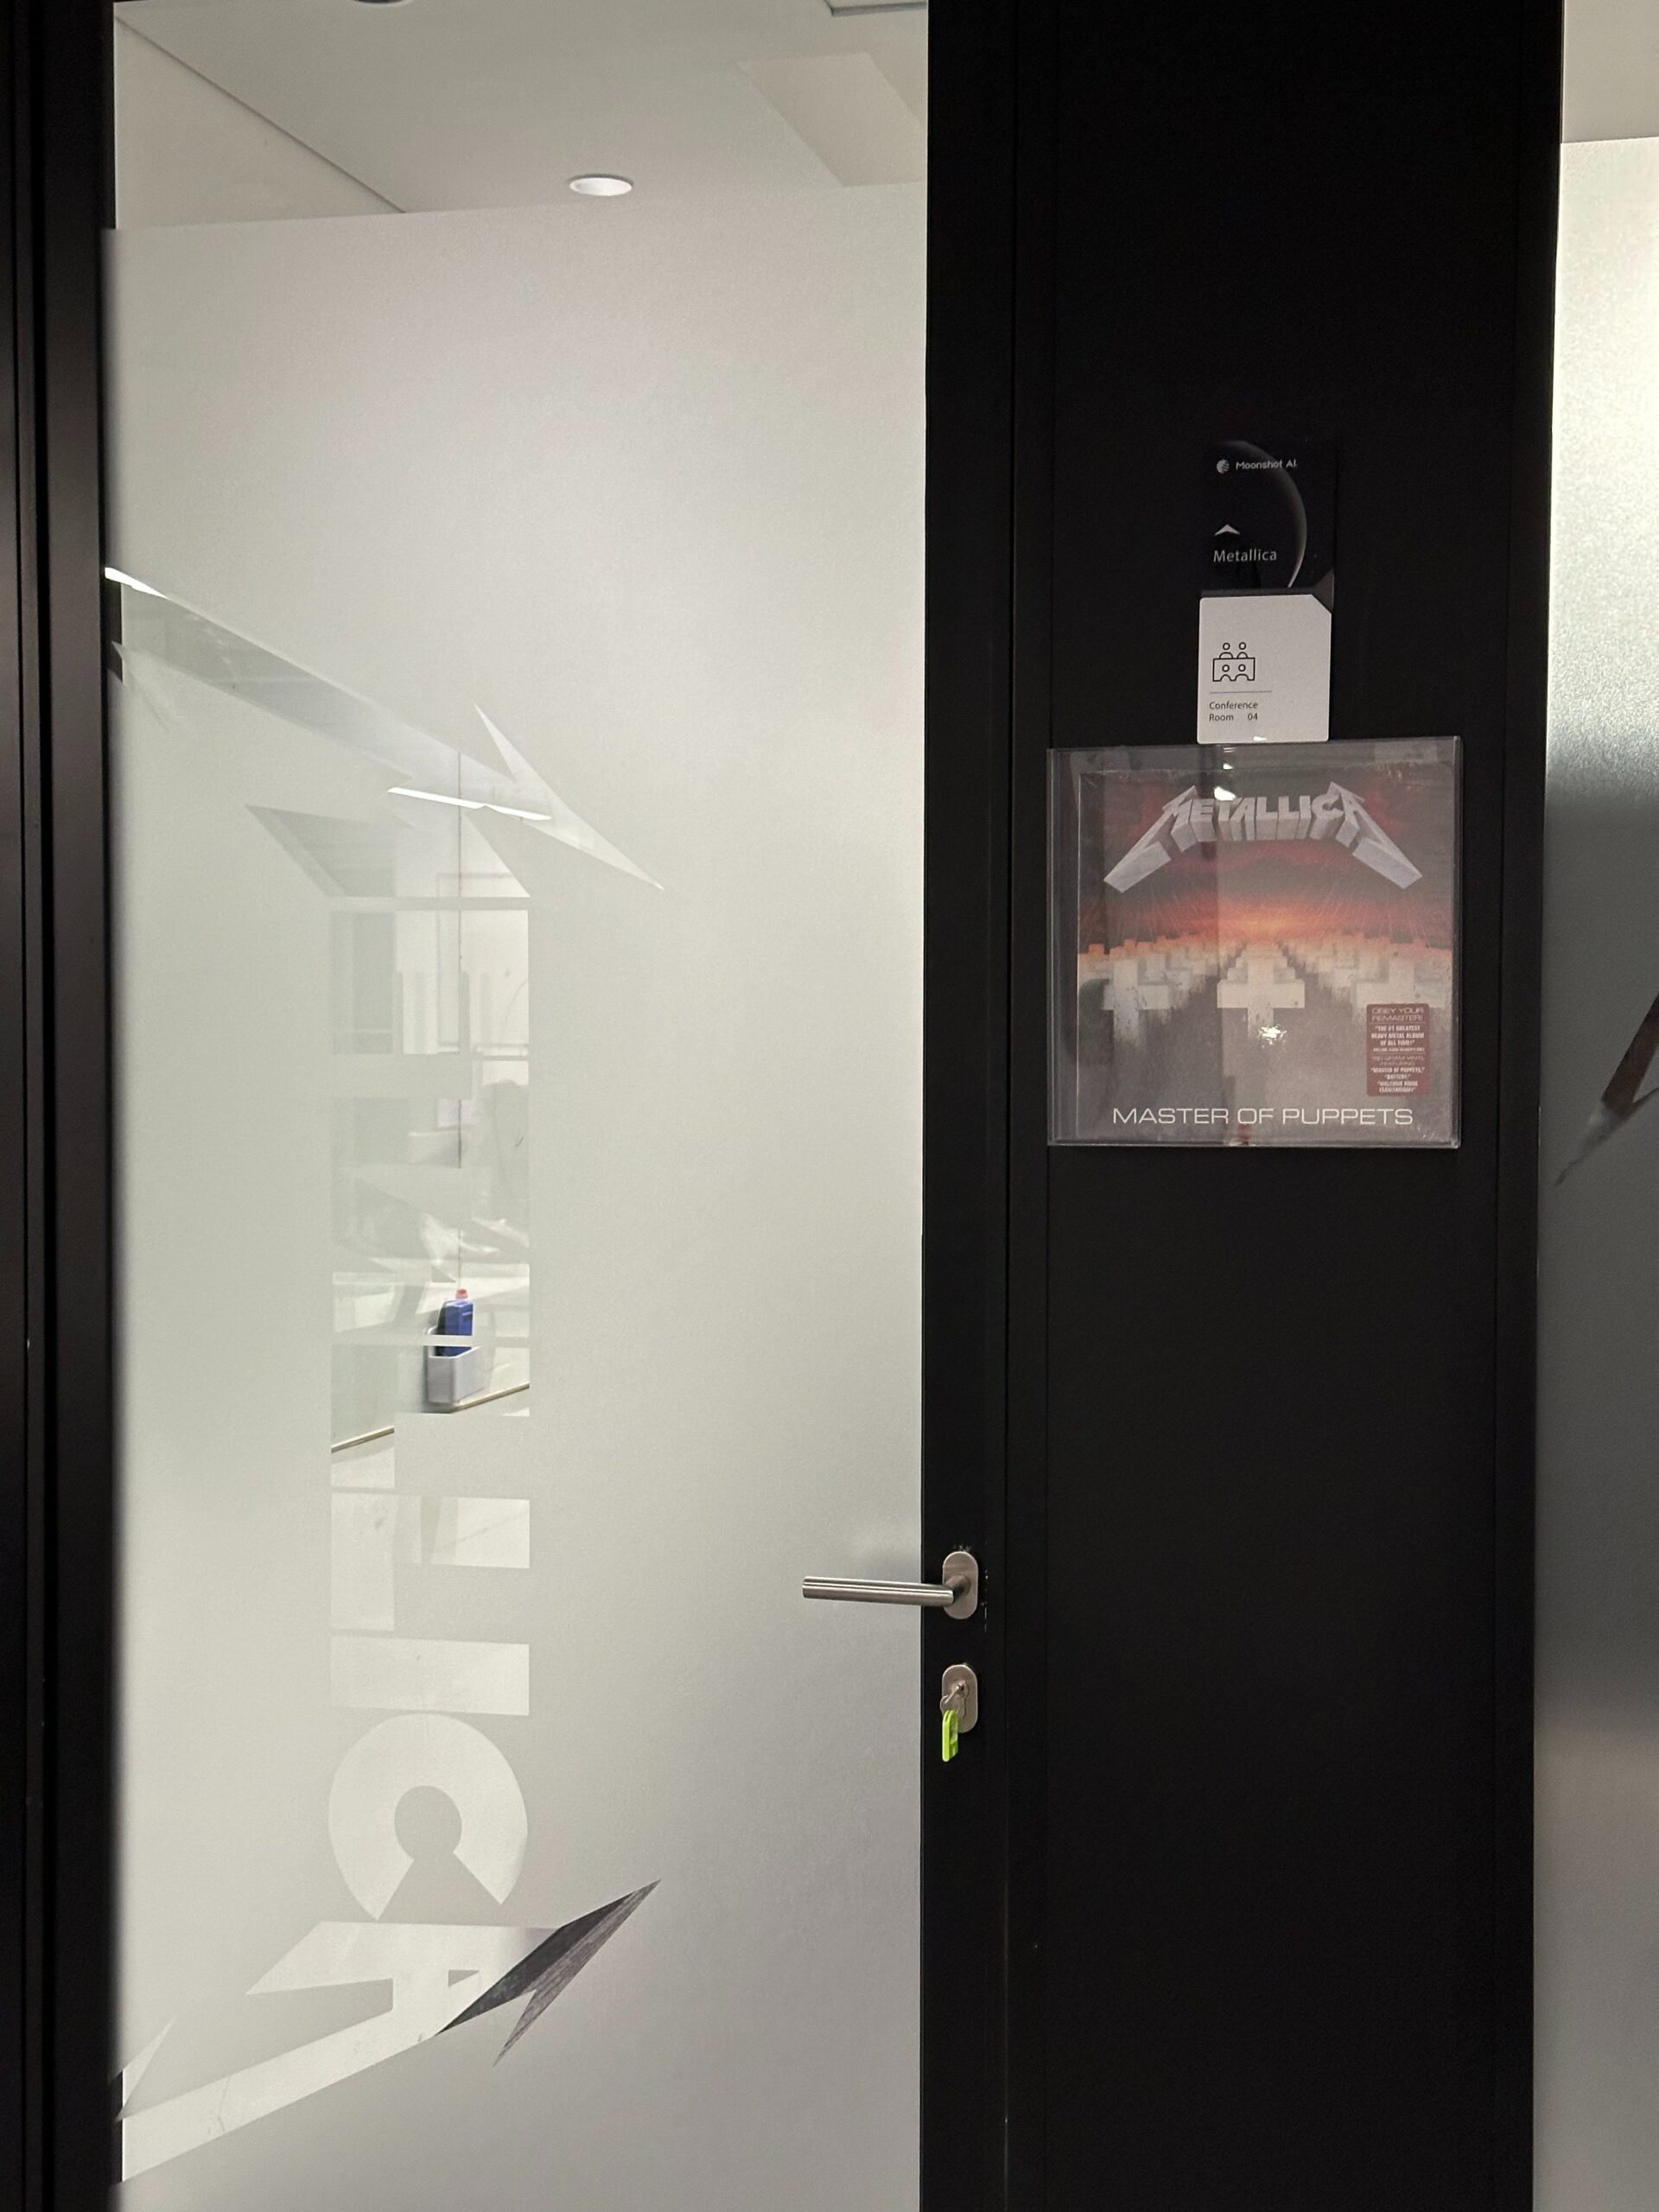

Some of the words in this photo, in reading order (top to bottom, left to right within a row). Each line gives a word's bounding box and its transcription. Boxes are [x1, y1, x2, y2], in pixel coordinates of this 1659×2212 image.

[1236, 460, 1283, 470] Moonshot
[1286, 459, 1297, 467] AI
[1213, 549, 1277, 563] Metallica
[1209, 701, 1259, 710] Conference
[1209, 713, 1234, 721] Room
[1103, 781, 1423, 893] METALLICA
[1113, 1108, 1229, 1124] MASTER
[1237, 1108, 1274, 1124] OF
[1282, 1108, 1413, 1125] PUPPETS
